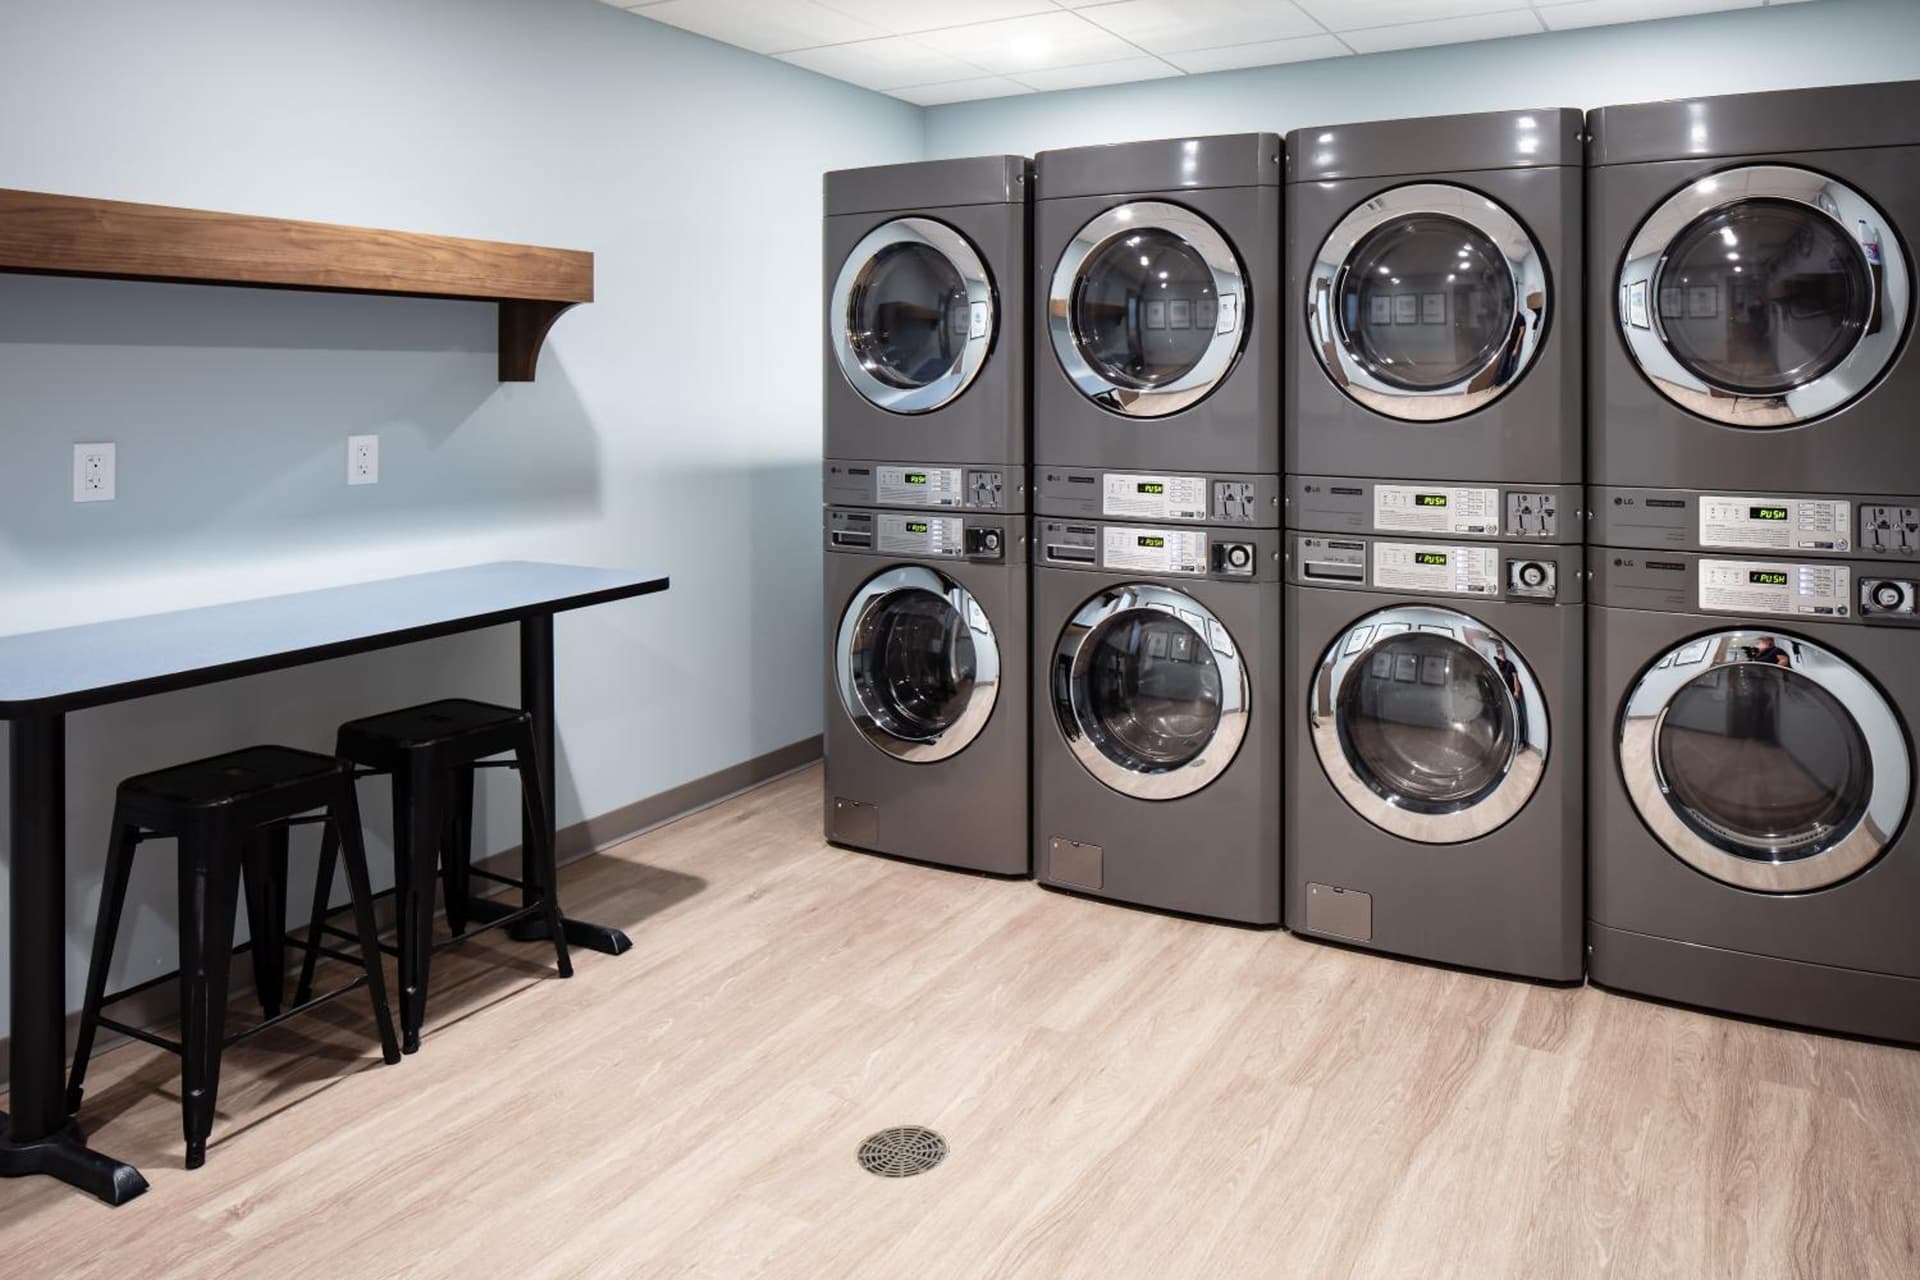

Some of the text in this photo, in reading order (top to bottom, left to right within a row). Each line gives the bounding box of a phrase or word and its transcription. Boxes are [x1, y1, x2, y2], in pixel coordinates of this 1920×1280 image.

[1424, 496, 1446, 505] PUSH
[1759, 509, 1786, 519] PUSH
[1424, 554, 1446, 564] PUSH
[1759, 574, 1786, 584] PUSH
